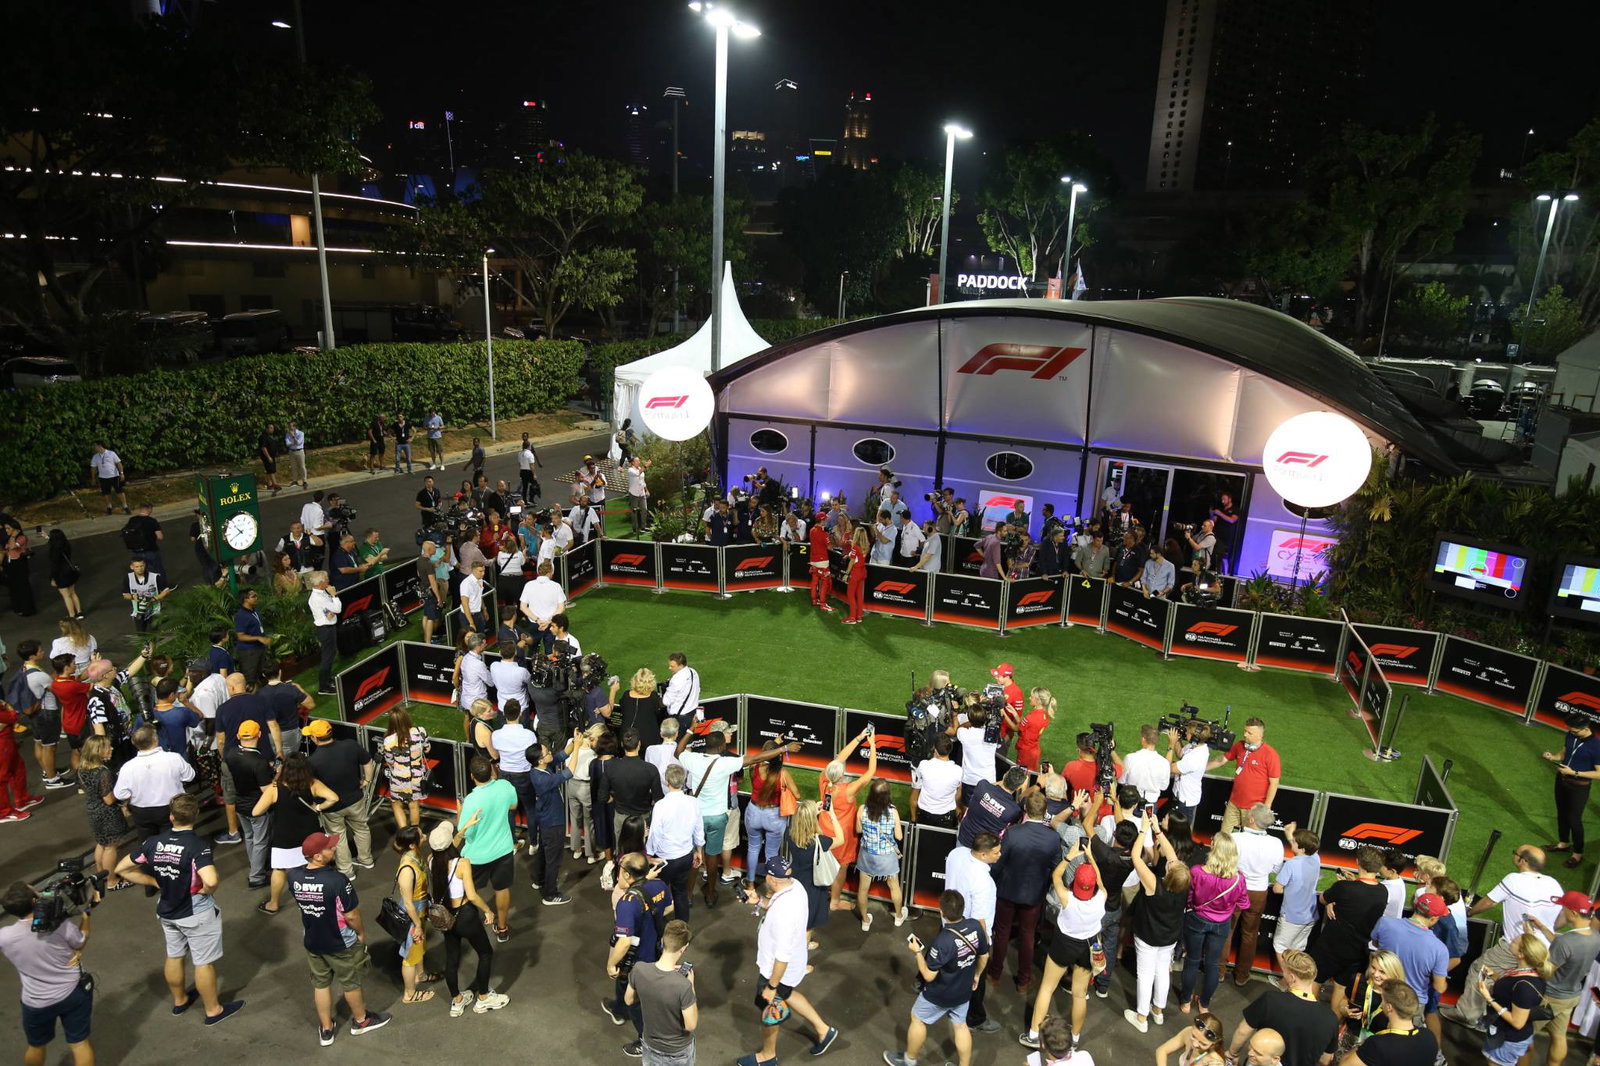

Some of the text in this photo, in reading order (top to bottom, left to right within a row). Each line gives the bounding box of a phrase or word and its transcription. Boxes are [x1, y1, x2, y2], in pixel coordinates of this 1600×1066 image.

[957, 274, 1028, 290] PADDOCK
[219, 492, 252, 506] ROLEX
[799, 545, 807, 554] 2
[1081, 580, 1092, 588] 4
[1340, 823, 1424, 845] F1
[164, 844, 185, 854] BWT
[1339, 839, 1356, 849] FIA
[302, 883, 324, 892] BWT
